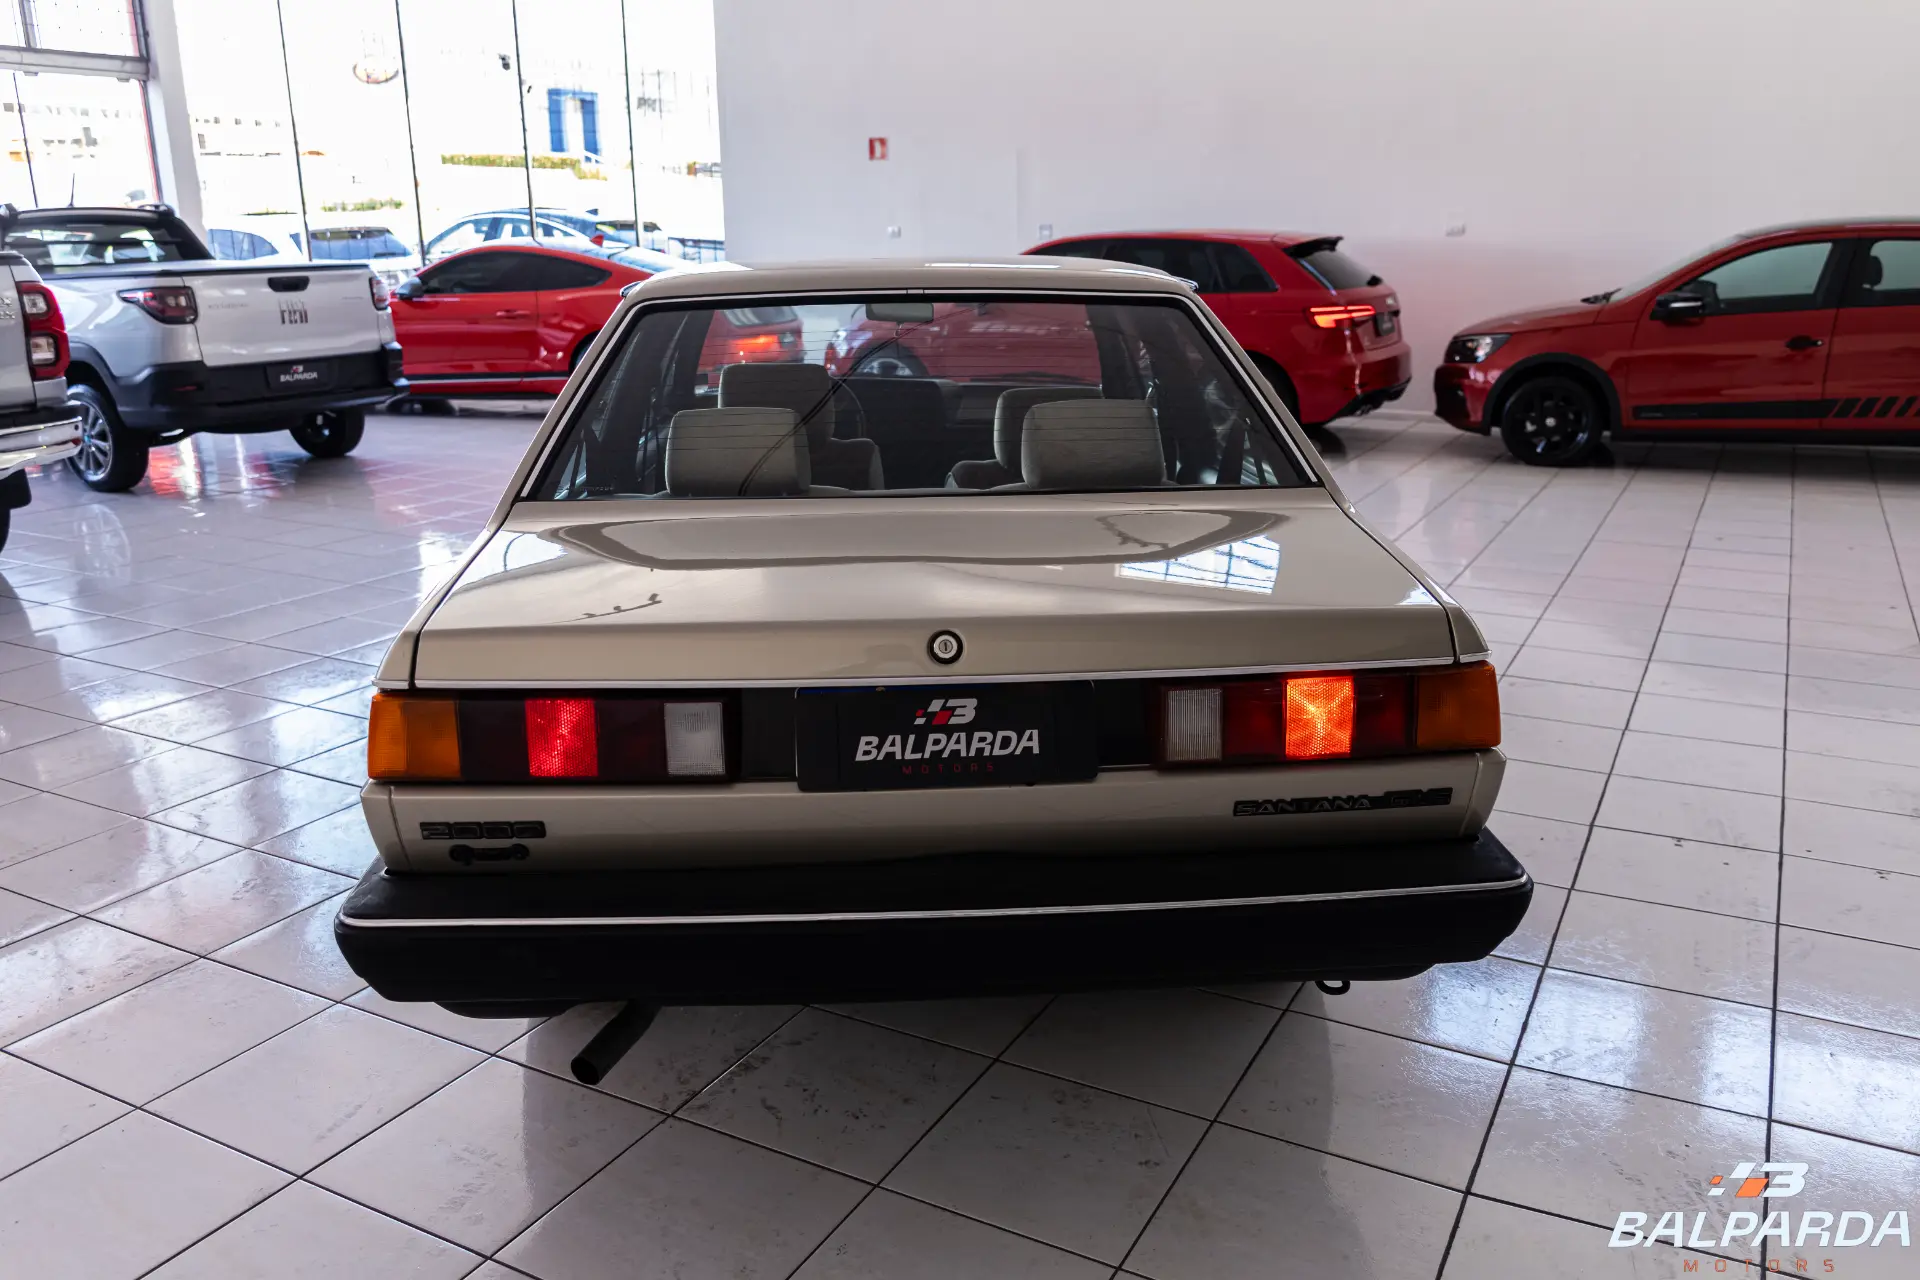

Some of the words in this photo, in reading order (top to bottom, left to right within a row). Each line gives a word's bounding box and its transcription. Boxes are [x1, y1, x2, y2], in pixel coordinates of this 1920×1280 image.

[280, 372, 318, 382] BALPARDA
[855, 729, 1040, 761] BALPARDA
[902, 763, 995, 775] MOTORS
[1234, 796, 1372, 816] SANTANA
[420, 821, 546, 839] 2000
